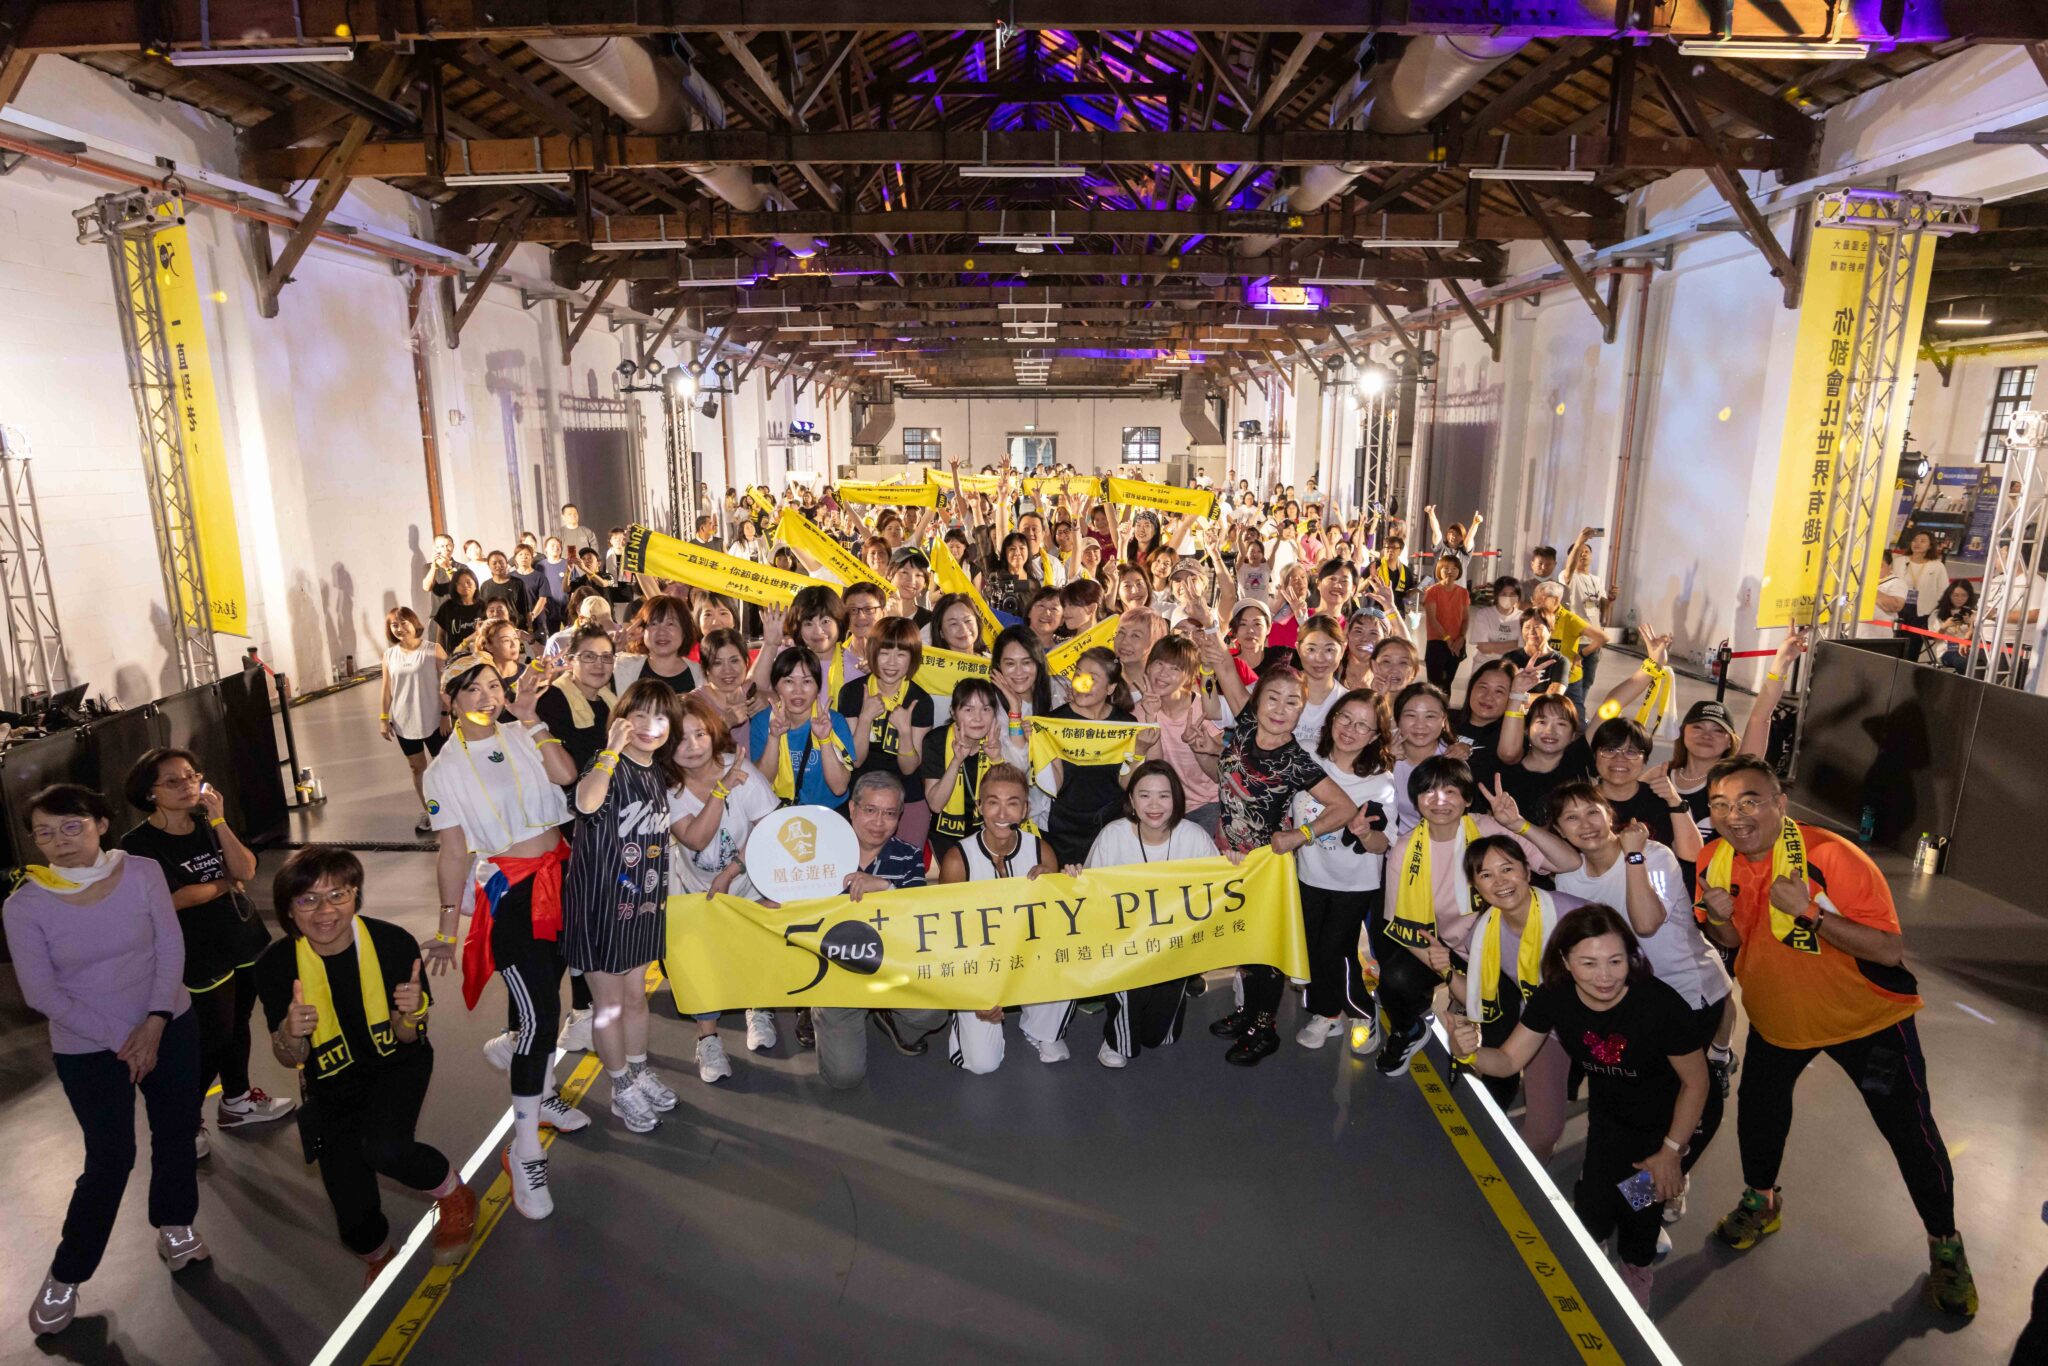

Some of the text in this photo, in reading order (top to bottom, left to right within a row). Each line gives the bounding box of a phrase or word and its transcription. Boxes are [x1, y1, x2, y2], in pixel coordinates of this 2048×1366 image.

[627, 551, 639, 571] FIT
[940, 818, 966, 832] FUN
[193, 852, 211, 861] TEAM
[617, 902, 635, 920] 76
[914, 878, 1247, 953] FIFTY PLUS
[1390, 922, 1413, 941] FUN
[827, 941, 877, 961] PLUS
[916, 919, 1248, 980] 用新的方法，創造自己的理想老後
[318, 1043, 345, 1071] FIT
[1514, 1229, 1604, 1351] 小心高台
